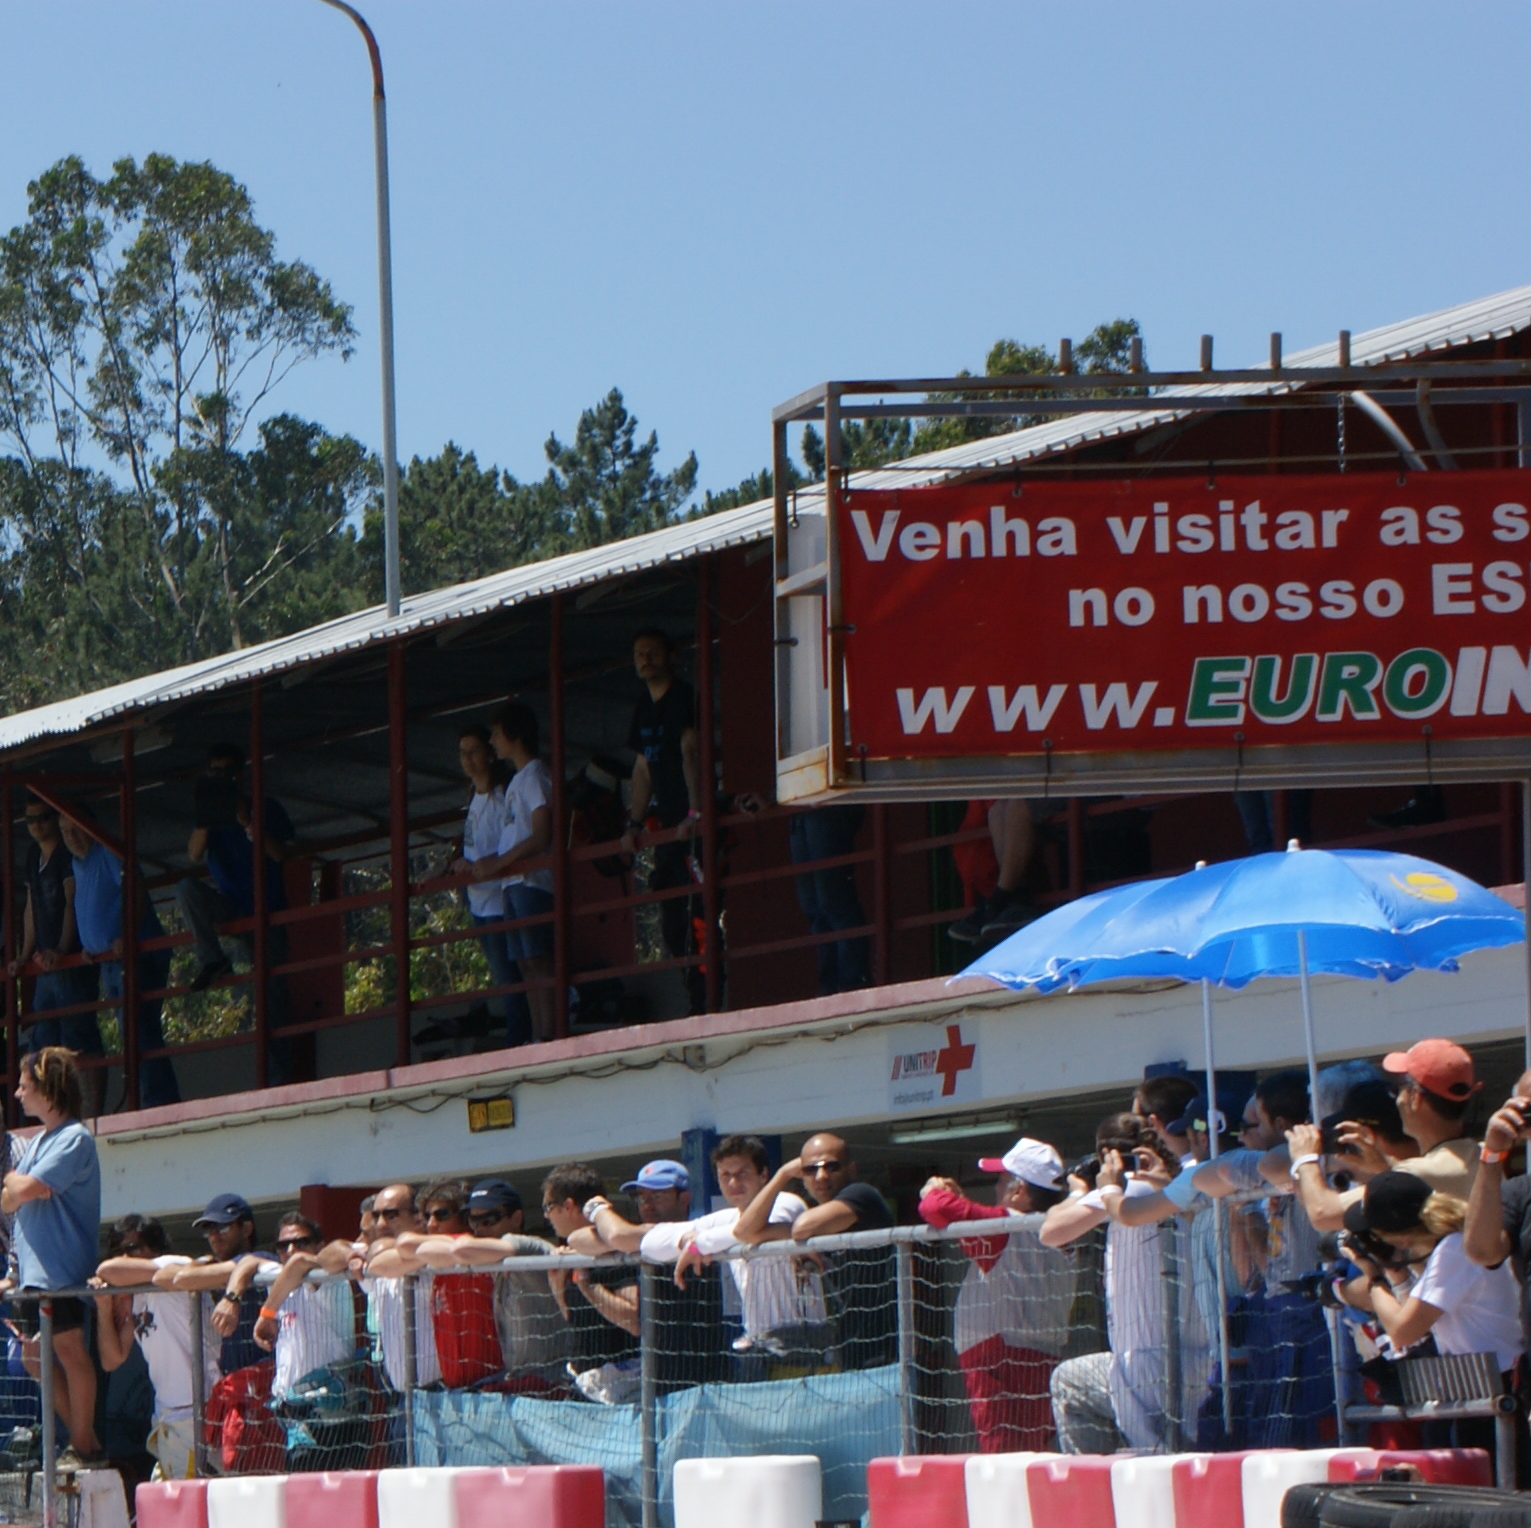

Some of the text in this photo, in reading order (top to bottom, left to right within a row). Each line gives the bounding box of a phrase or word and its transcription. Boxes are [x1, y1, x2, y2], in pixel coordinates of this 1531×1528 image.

[850, 505, 1078, 562] Venha
[1105, 499, 1350, 556] visitar
[1379, 504, 1464, 546] as
[1068, 560, 1531, 628] no nosso ES
